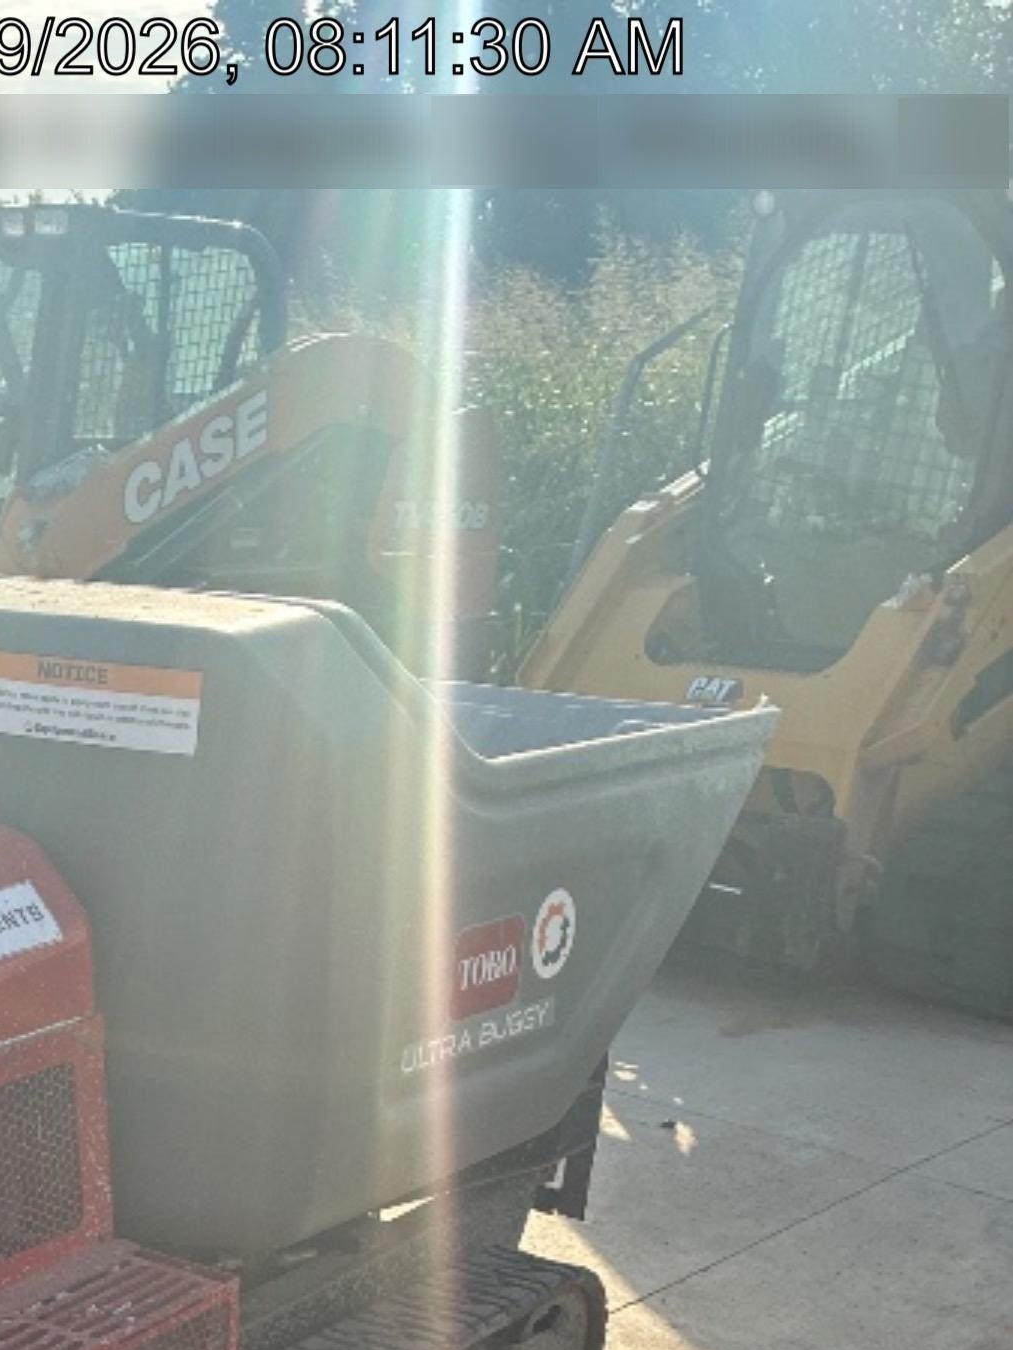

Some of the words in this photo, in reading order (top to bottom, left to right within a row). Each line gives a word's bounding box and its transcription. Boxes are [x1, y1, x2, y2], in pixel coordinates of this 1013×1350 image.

[124, 389, 268, 523] CASE
[37, 661, 109, 685] NOTICE
[686, 676, 737, 703] CAT
[458, 943, 517, 991] TORO
[399, 1026, 472, 1075] ULTRA
[478, 1000, 550, 1050] BUGGY
